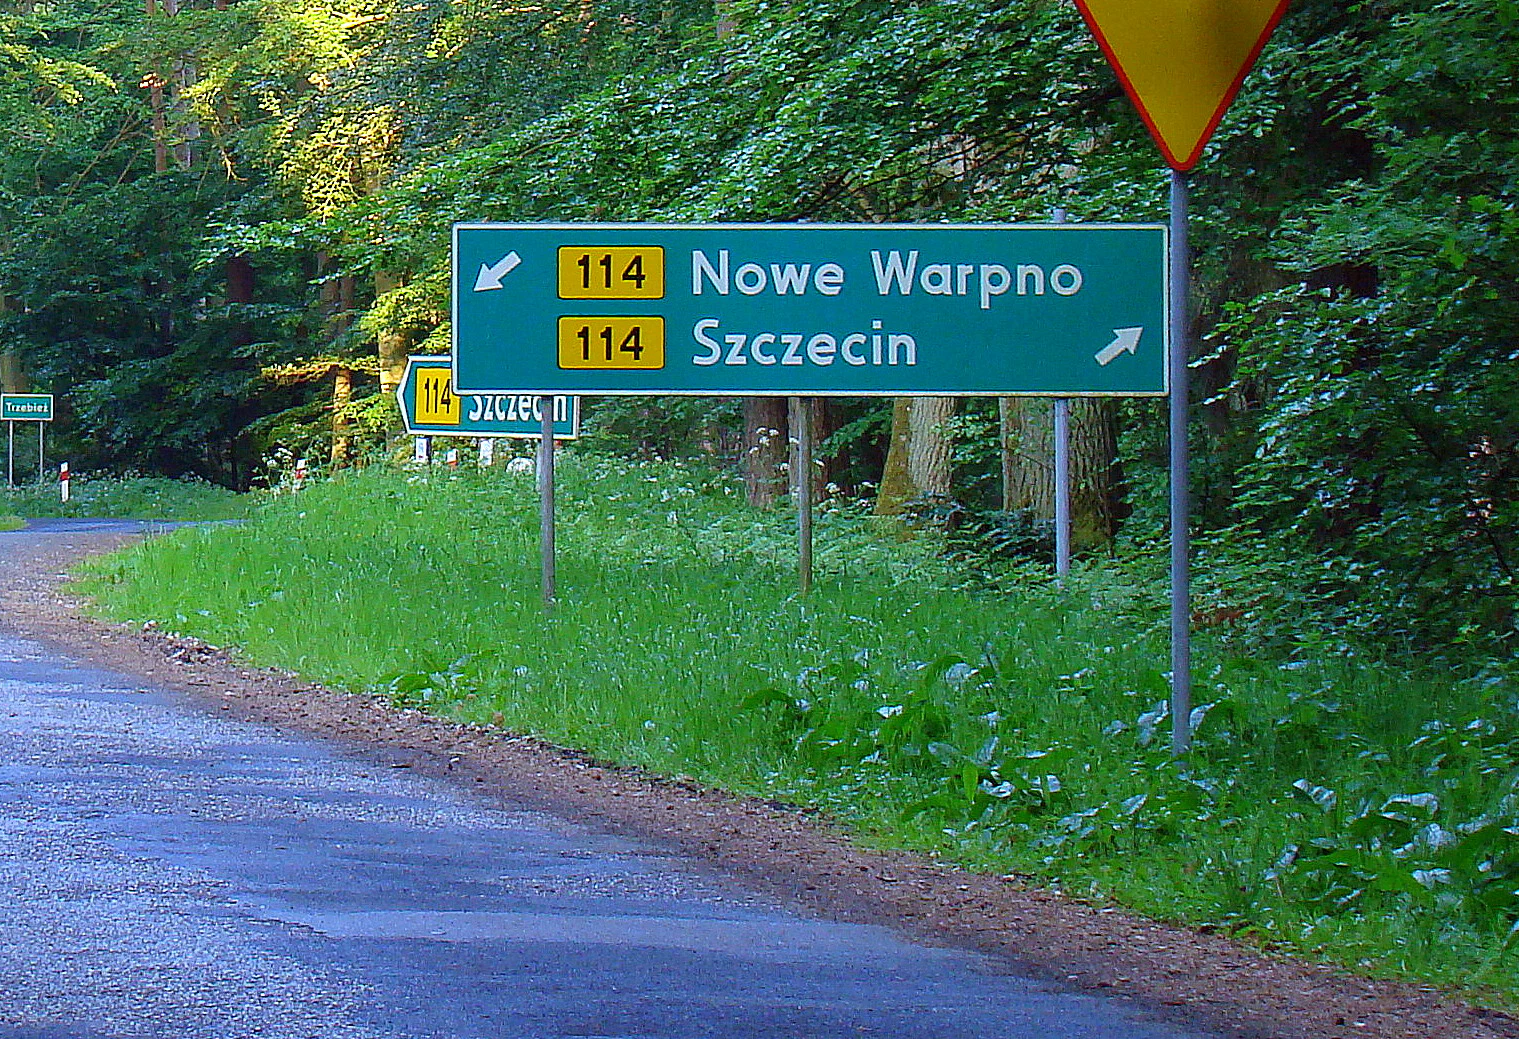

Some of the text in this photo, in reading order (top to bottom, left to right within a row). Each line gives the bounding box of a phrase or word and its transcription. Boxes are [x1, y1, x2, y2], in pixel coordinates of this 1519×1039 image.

[577, 249, 1083, 309] 114 Nowe Warpno
[576, 317, 918, 366] 114 Szczecin
[424, 377, 567, 422] 114 Szczecn
